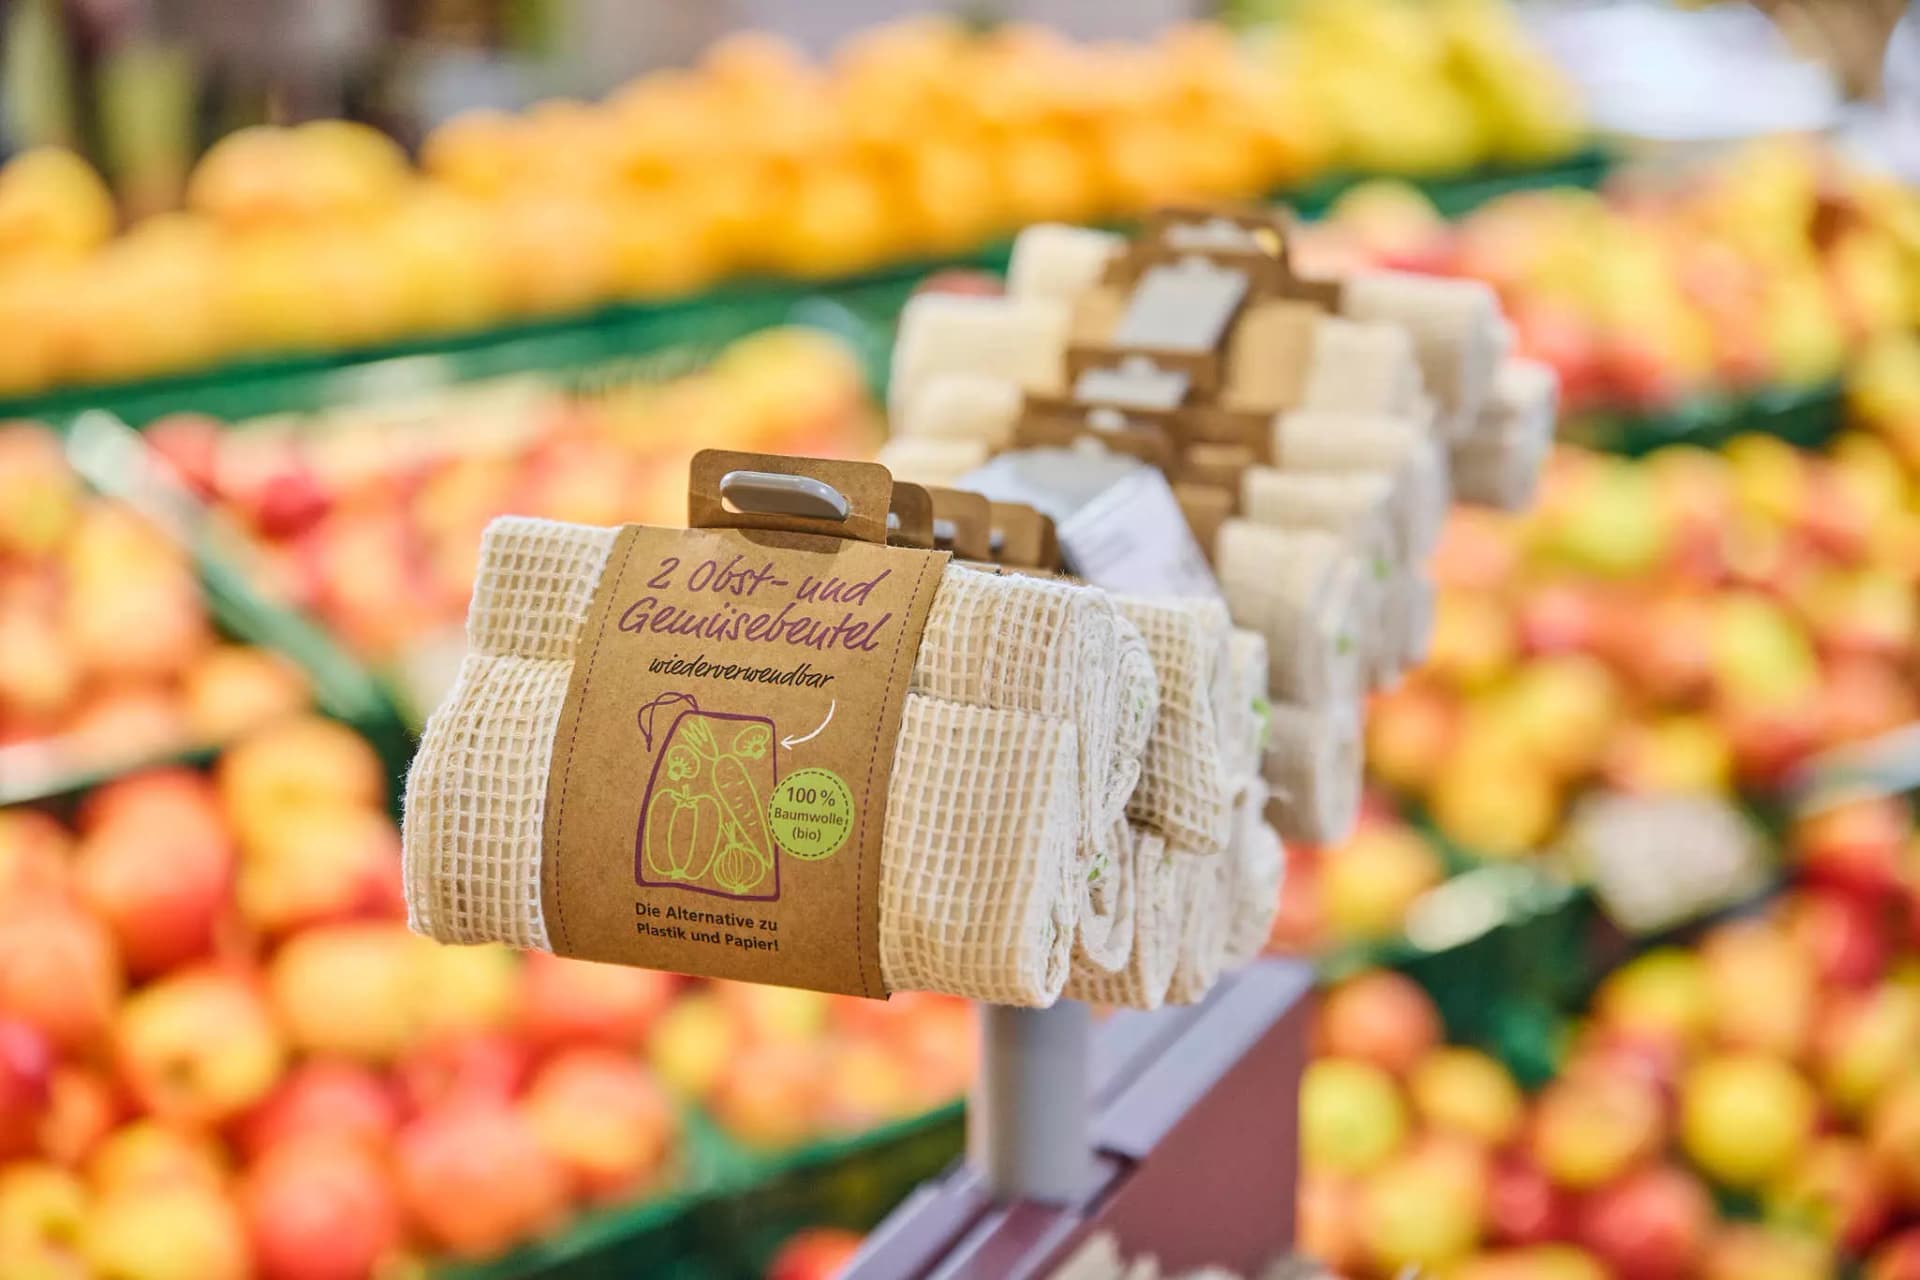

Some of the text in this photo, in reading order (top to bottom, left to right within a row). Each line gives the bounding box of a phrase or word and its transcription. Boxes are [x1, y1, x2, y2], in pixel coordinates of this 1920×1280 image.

[647, 554, 893, 606] 2 Obst- und
[618, 596, 893, 651] Gemüsebeutel
[648, 653, 835, 689] wiederverwendbar
[787, 786, 836, 807] 100 %
[774, 807, 844, 826] Baumwolle
[792, 822, 822, 842] (bio)
[635, 902, 778, 931] Die Alternative zu
[637, 923, 779, 951] Plastik und Papier!
